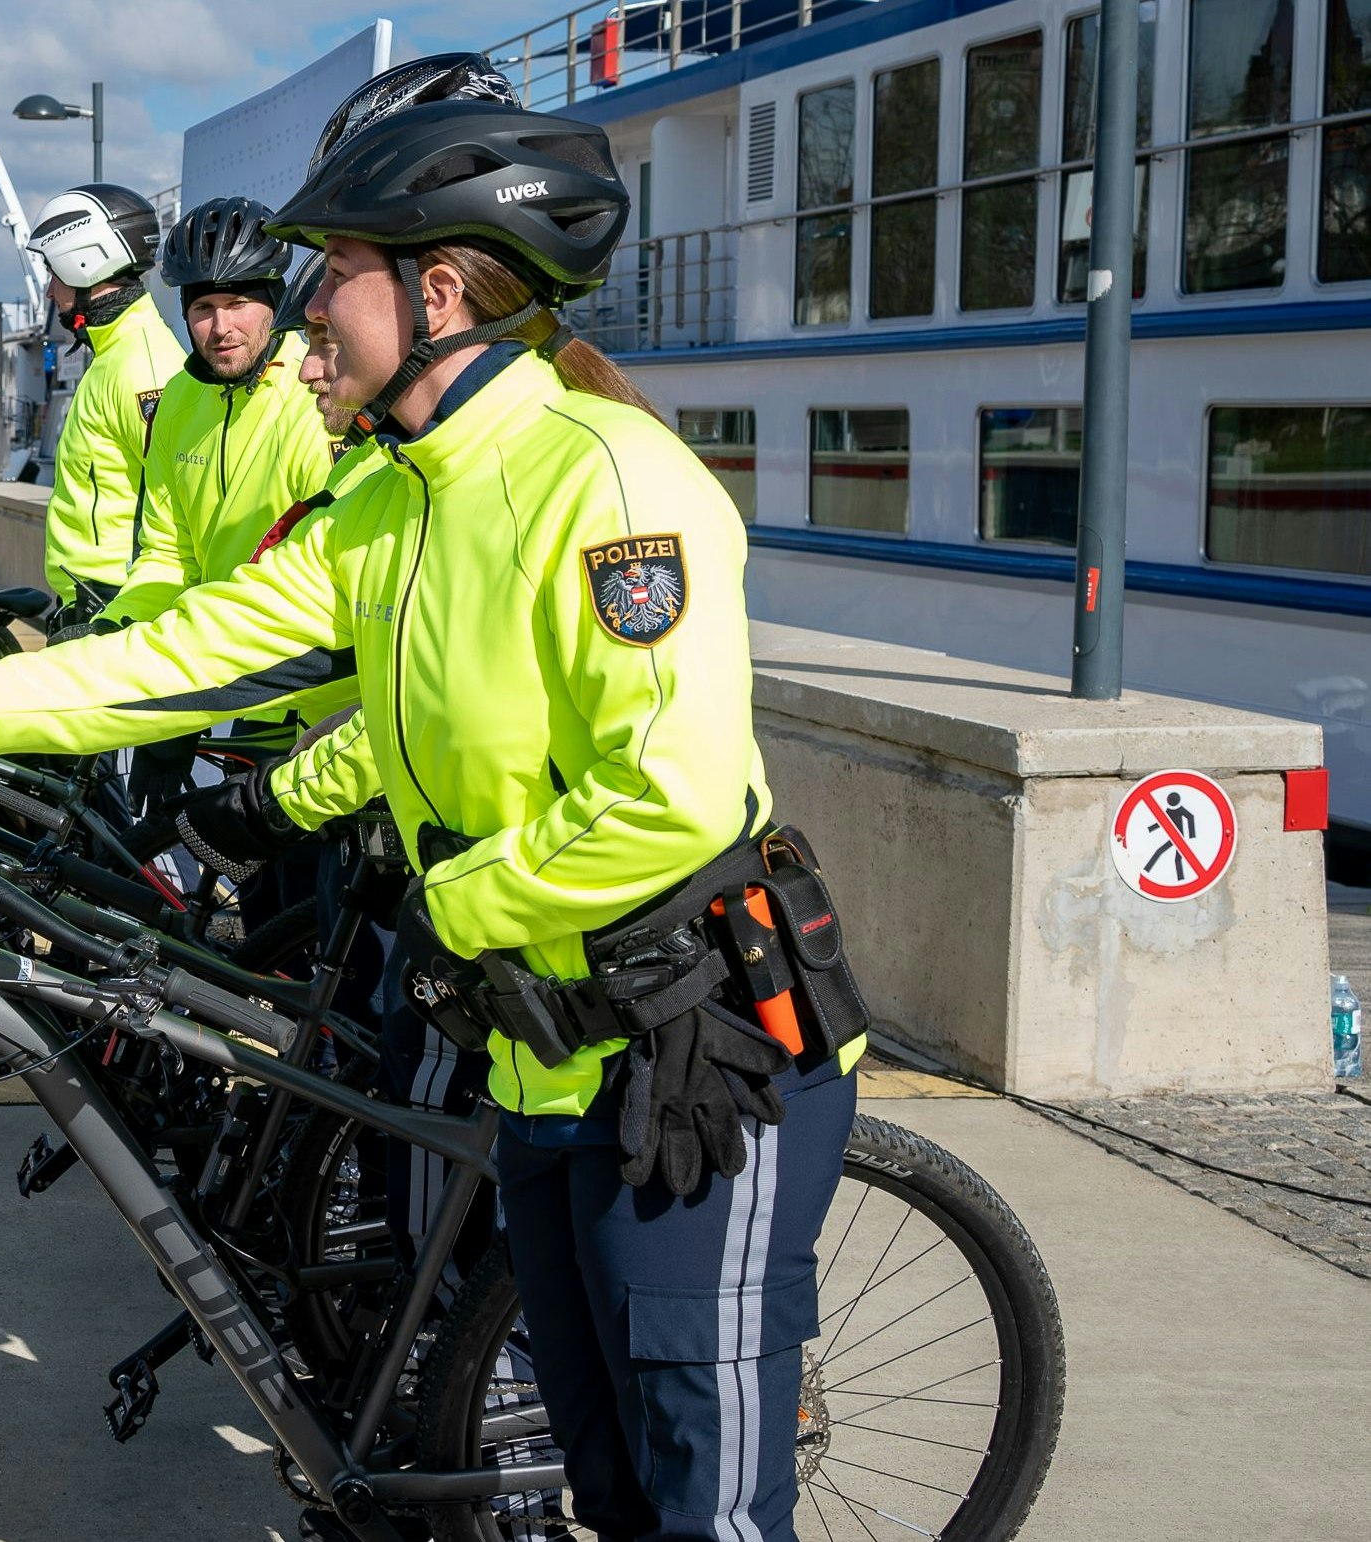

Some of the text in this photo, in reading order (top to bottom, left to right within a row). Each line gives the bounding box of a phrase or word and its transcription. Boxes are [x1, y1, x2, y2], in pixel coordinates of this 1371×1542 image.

[495, 180, 549, 204] uvex
[40, 218, 92, 247] CRATONI
[589, 539, 677, 571] POLIZEI
[843, 1148, 914, 1178] RAC
[139, 1206, 295, 1416] CUBE
